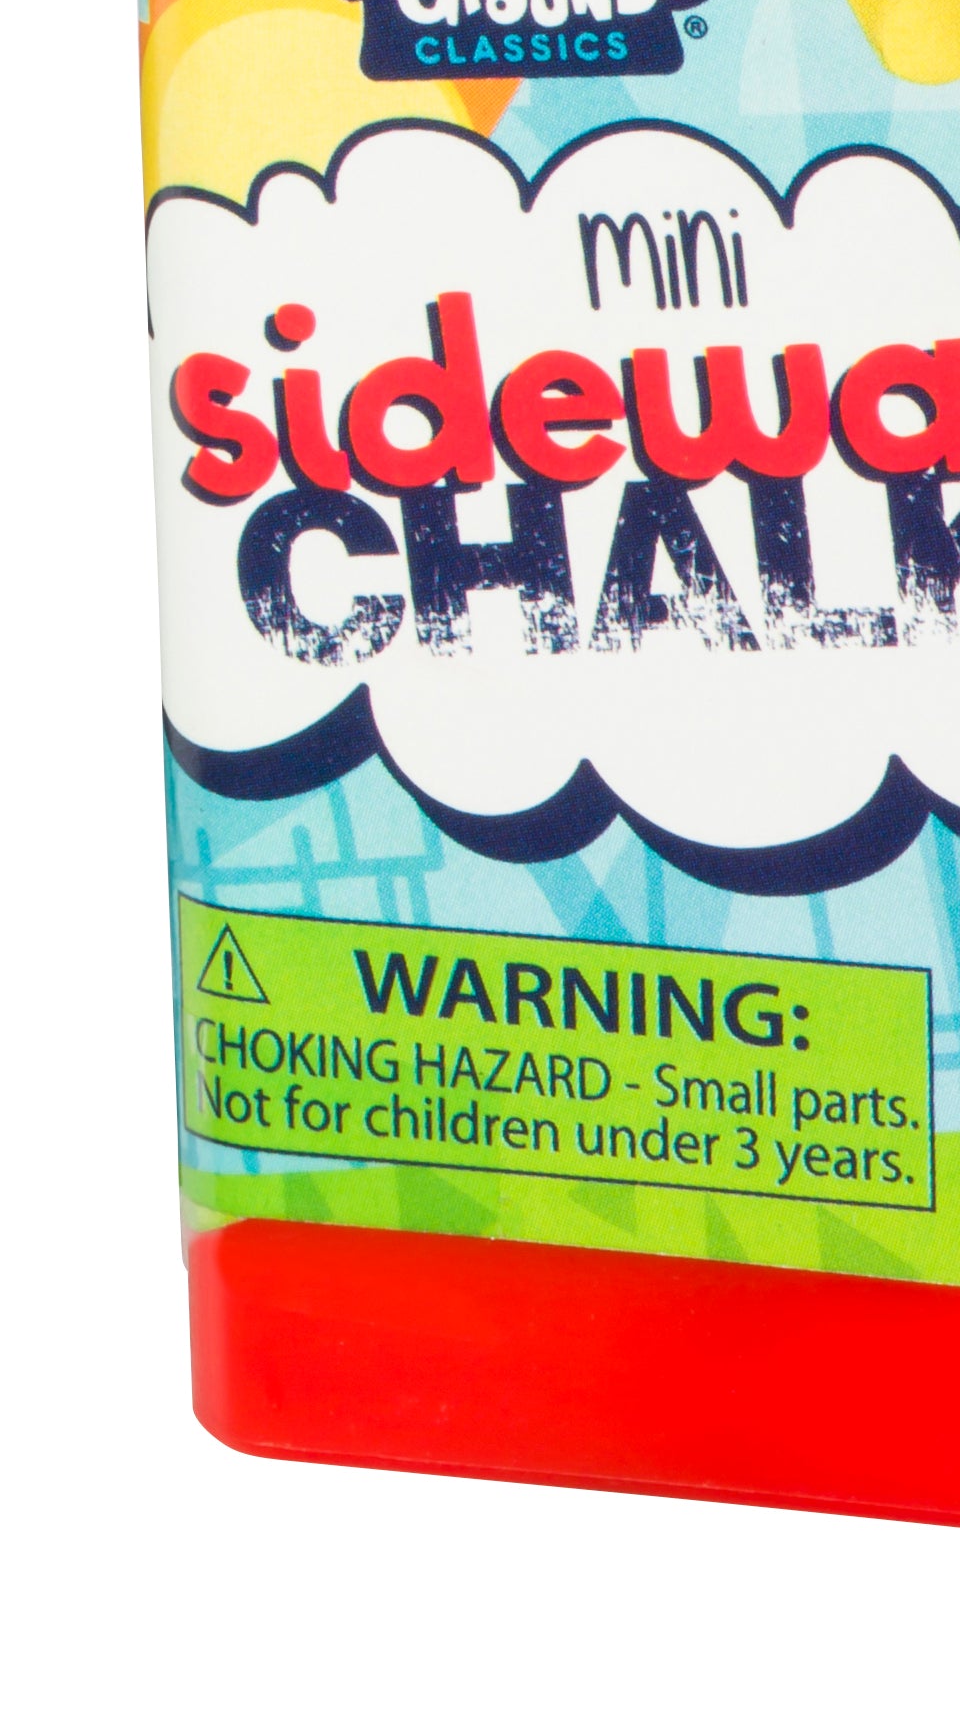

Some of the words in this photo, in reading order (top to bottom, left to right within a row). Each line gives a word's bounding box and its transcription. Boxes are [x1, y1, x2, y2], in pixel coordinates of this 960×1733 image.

[415, 31, 630, 66] CLASSICS
[578, 208, 748, 309] mini
[352, 948, 812, 1052] WARNING:
[196, 1016, 400, 1083] CHOKING
[413, 1042, 612, 1101] HAZARD
[655, 1062, 778, 1118] Small
[792, 1084, 921, 1133] parts.
[198, 1076, 271, 1128] Not
[283, 1080, 349, 1135] for
[364, 1088, 560, 1152] children
[576, 1114, 720, 1167] under
[734, 1128, 761, 1169] 3
[774, 1138, 916, 1185] years.
